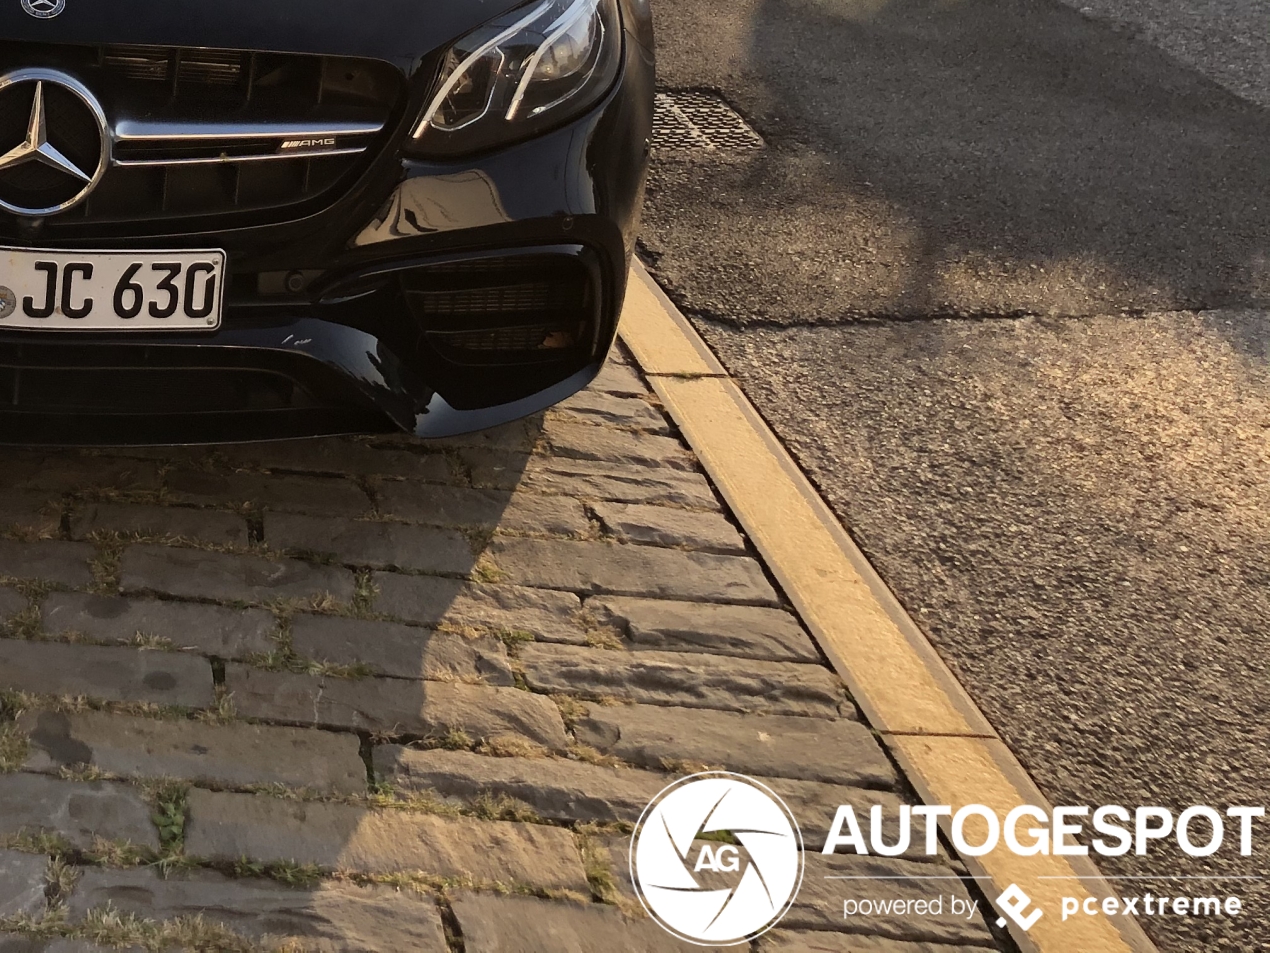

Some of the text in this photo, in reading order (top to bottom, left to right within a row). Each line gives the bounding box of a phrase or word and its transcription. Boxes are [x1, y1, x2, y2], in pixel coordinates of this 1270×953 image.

[299, 138, 335, 147] AMG
[23, 260, 94, 319] JC
[113, 262, 217, 319] 630
